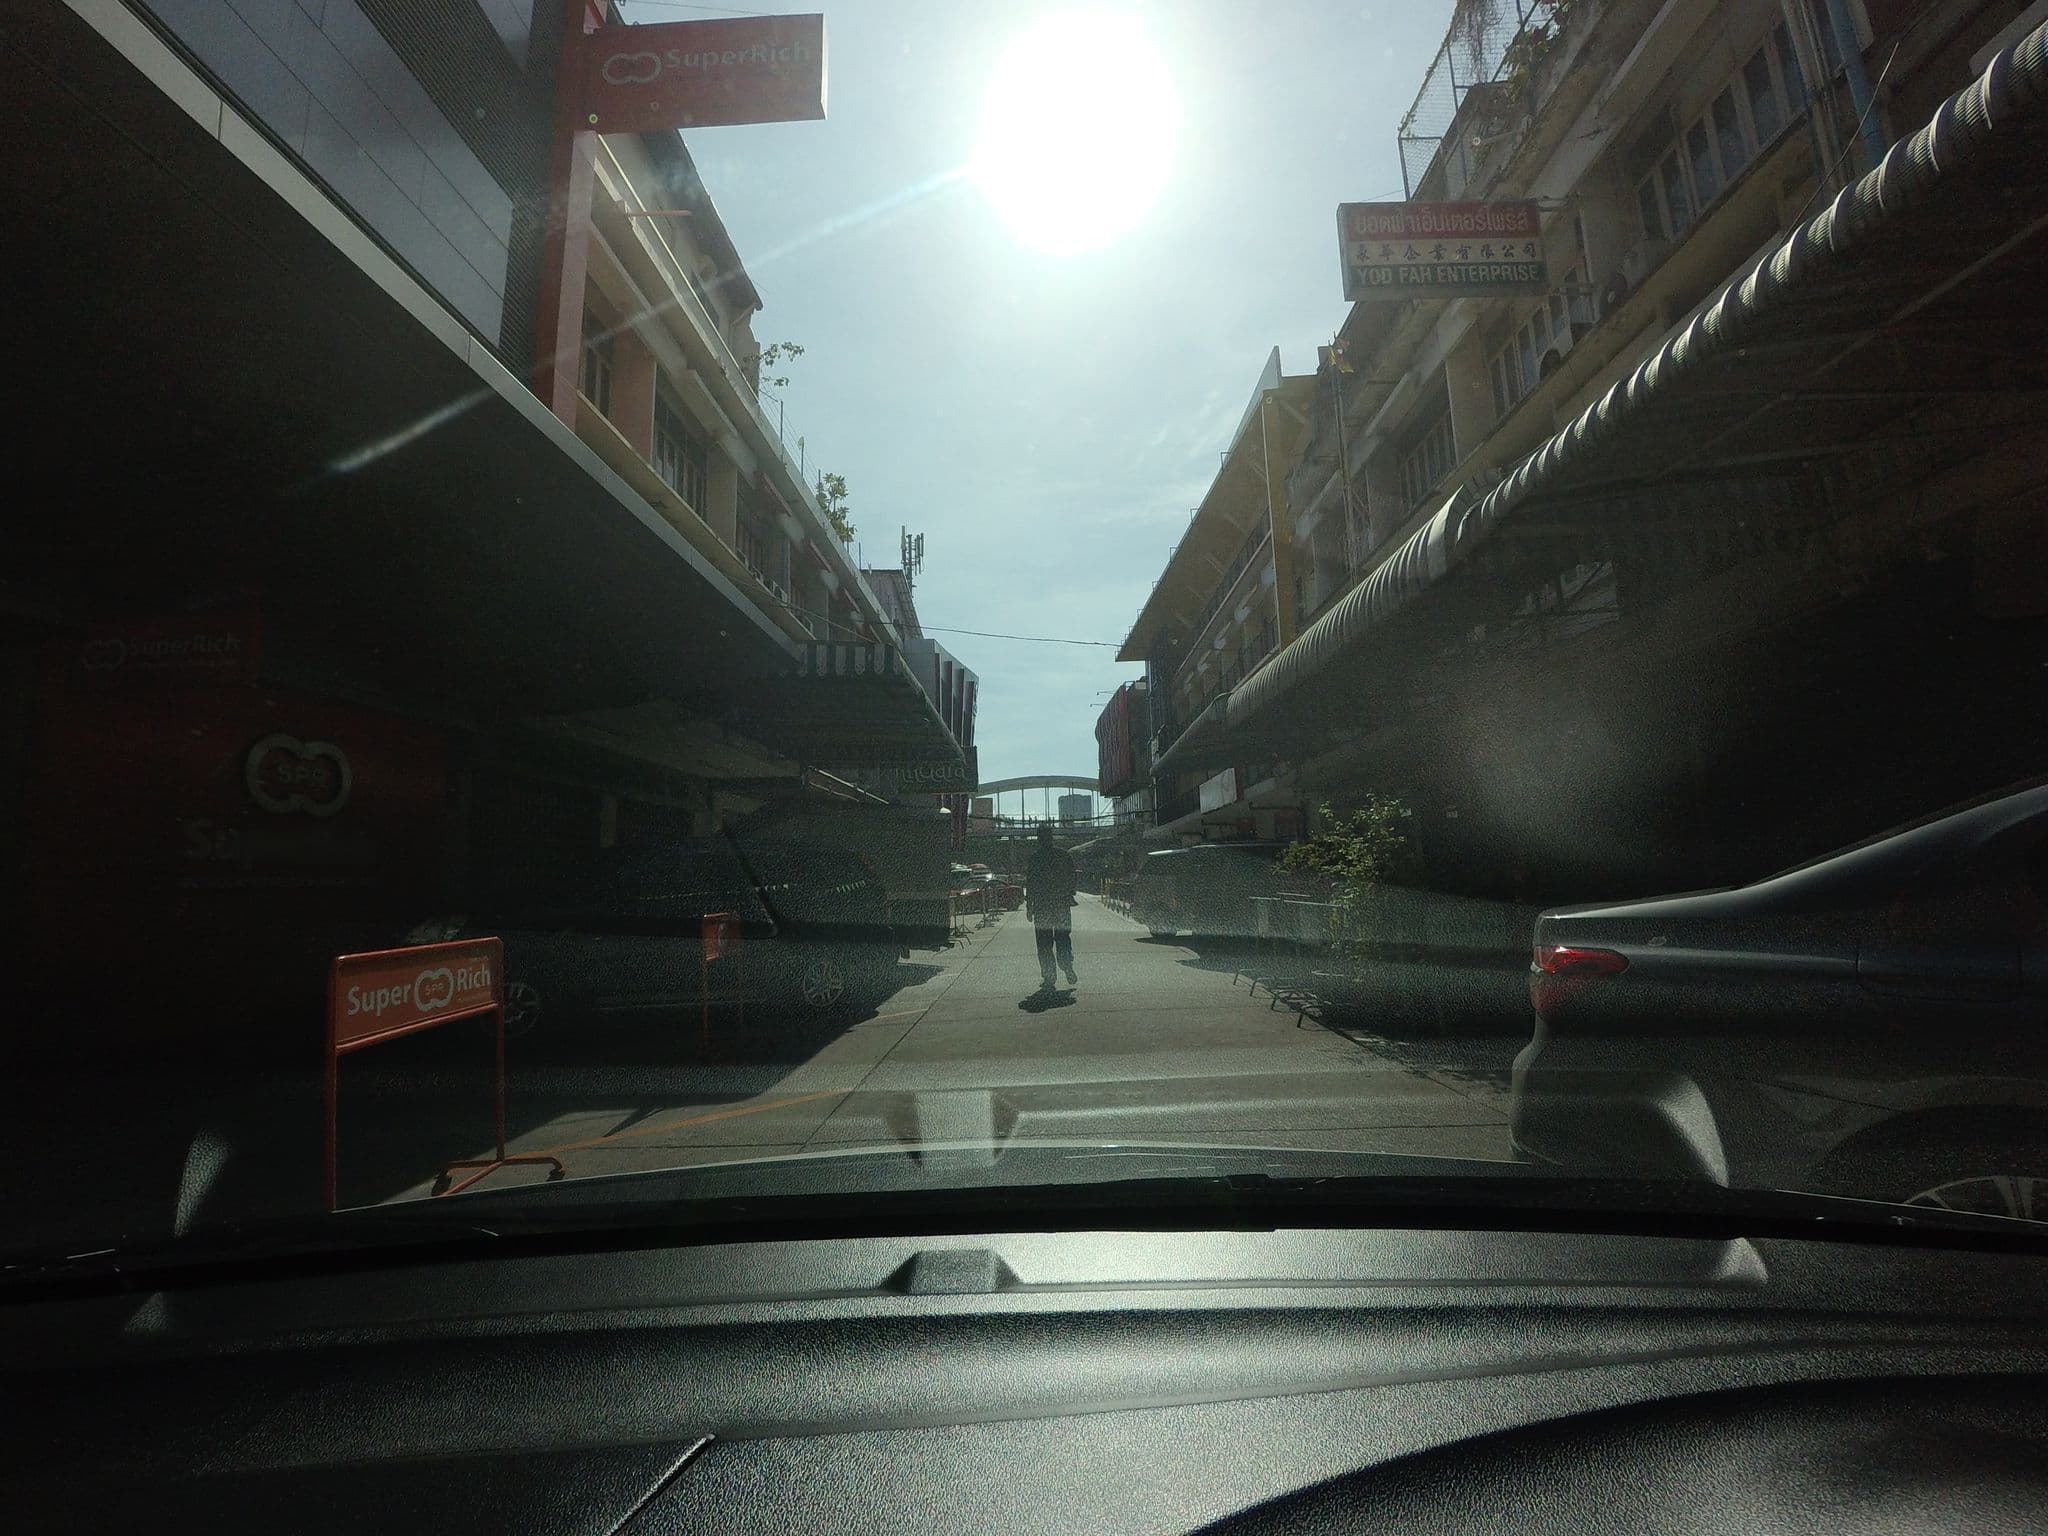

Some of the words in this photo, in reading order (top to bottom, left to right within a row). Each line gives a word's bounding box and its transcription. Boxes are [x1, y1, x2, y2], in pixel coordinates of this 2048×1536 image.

[666, 41, 809, 73] SuperRich
[1399, 264, 1432, 284] FAH
[1437, 262, 1539, 284] ENTERPRISE
[346, 984, 412, 1016] Super
[456, 964, 491, 992] Rich
